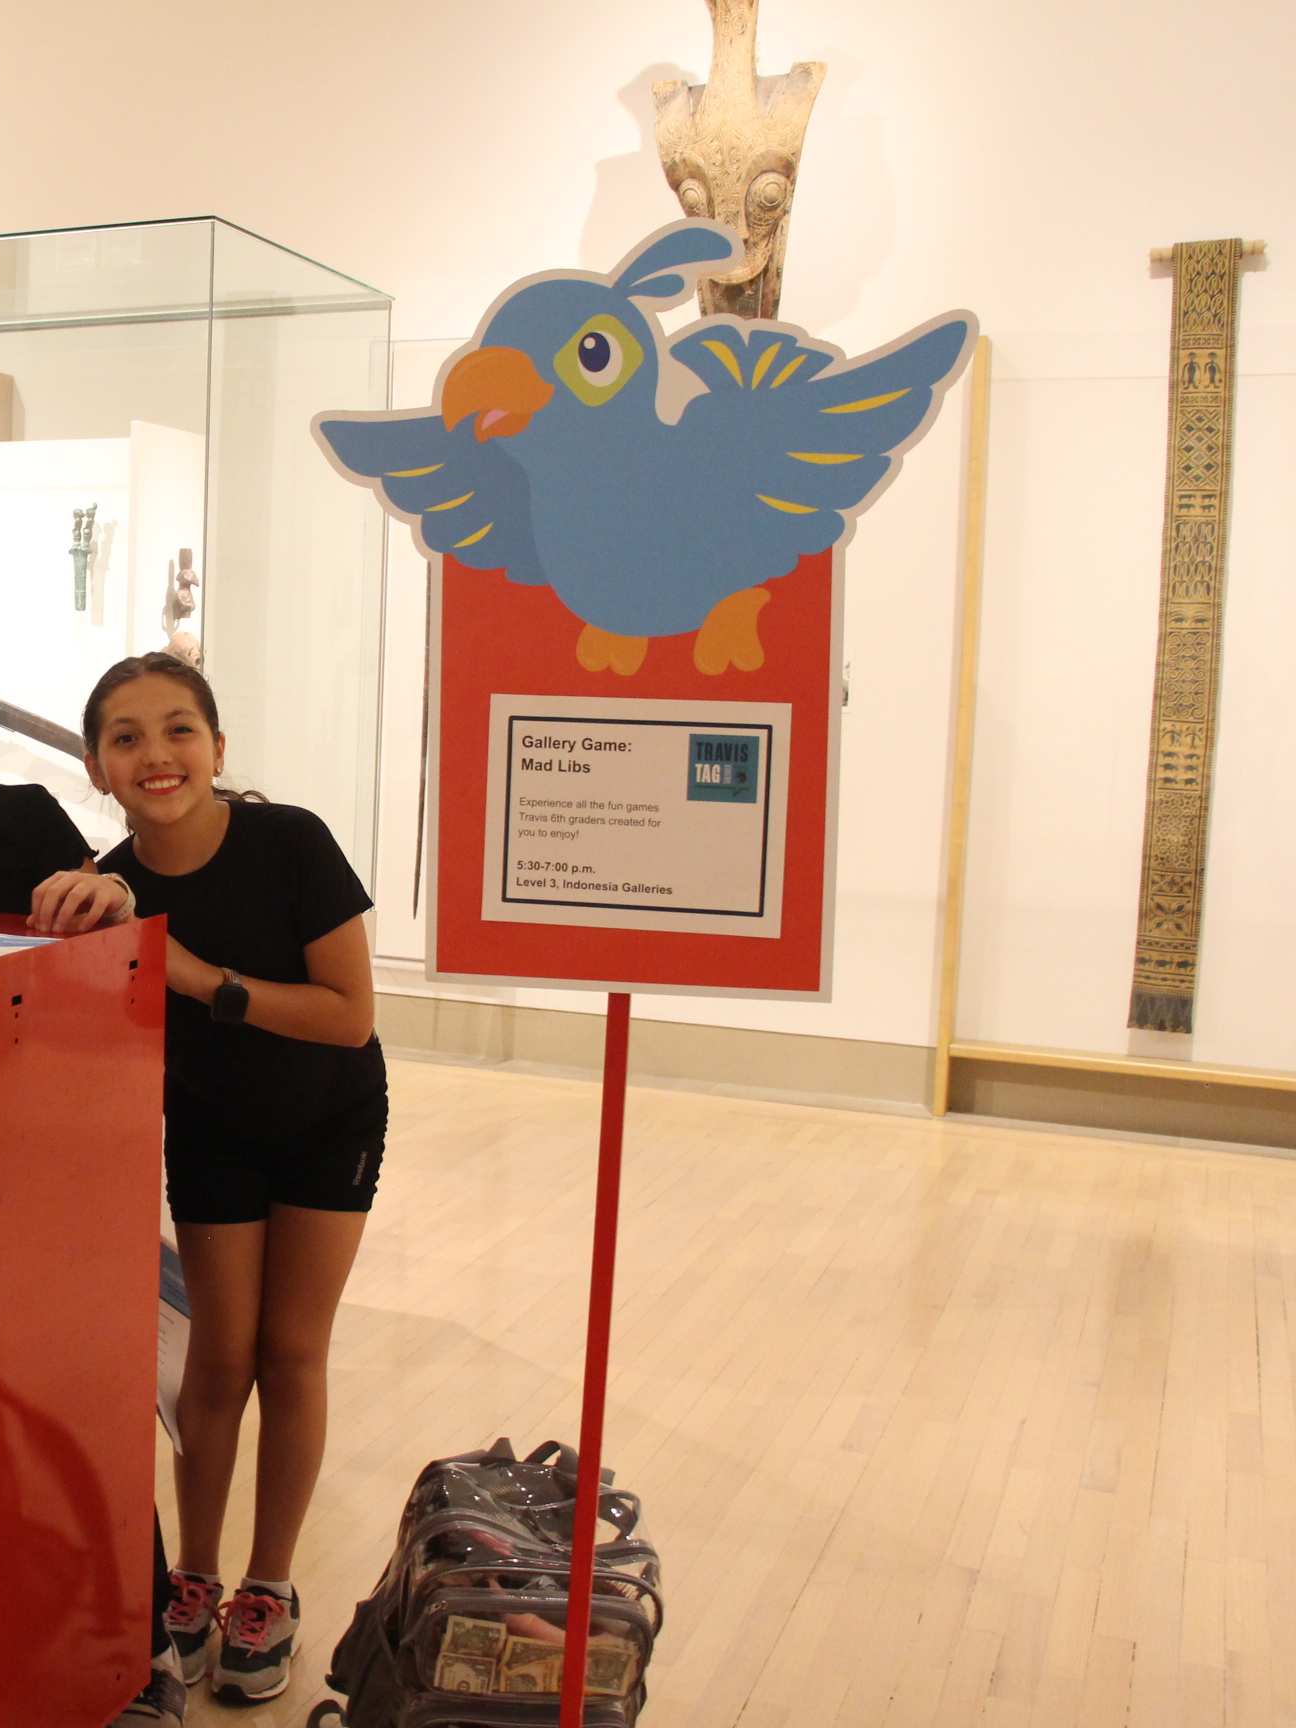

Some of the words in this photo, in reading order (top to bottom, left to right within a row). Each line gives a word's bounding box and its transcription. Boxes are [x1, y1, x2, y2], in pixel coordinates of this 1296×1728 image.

[521, 735, 577, 753] Gallery
[581, 737, 632, 752] Game:
[696, 741, 749, 763] TRAVIS
[521, 758, 553, 772] Mad
[557, 759, 591, 774] Libs
[694, 763, 721, 784] TAG
[518, 797, 573, 808] Experience
[575, 799, 587, 809] all
[589, 800, 605, 810] the
[607, 801, 623, 811] fun
[625, 803, 659, 813] games
[518, 811, 548, 823] Travis
[550, 813, 566, 823] 6th
[568, 815, 606, 826] graders
[608, 817, 645, 827] created
[647, 817, 662, 828] for
[517, 828, 536, 838] you
[537, 828, 548, 838] to
[549, 829, 580, 840] enjoy!
[516, 860, 569, 873] 5:30-7:00
[571, 864, 596, 875] p.m.
[516, 876, 547, 888] Level
[549, 878, 560, 890] 3,
[562, 879, 619, 892] Indonesia
[621, 882, 673, 895] Galleries
[352, 1151, 367, 1185] Reebok
